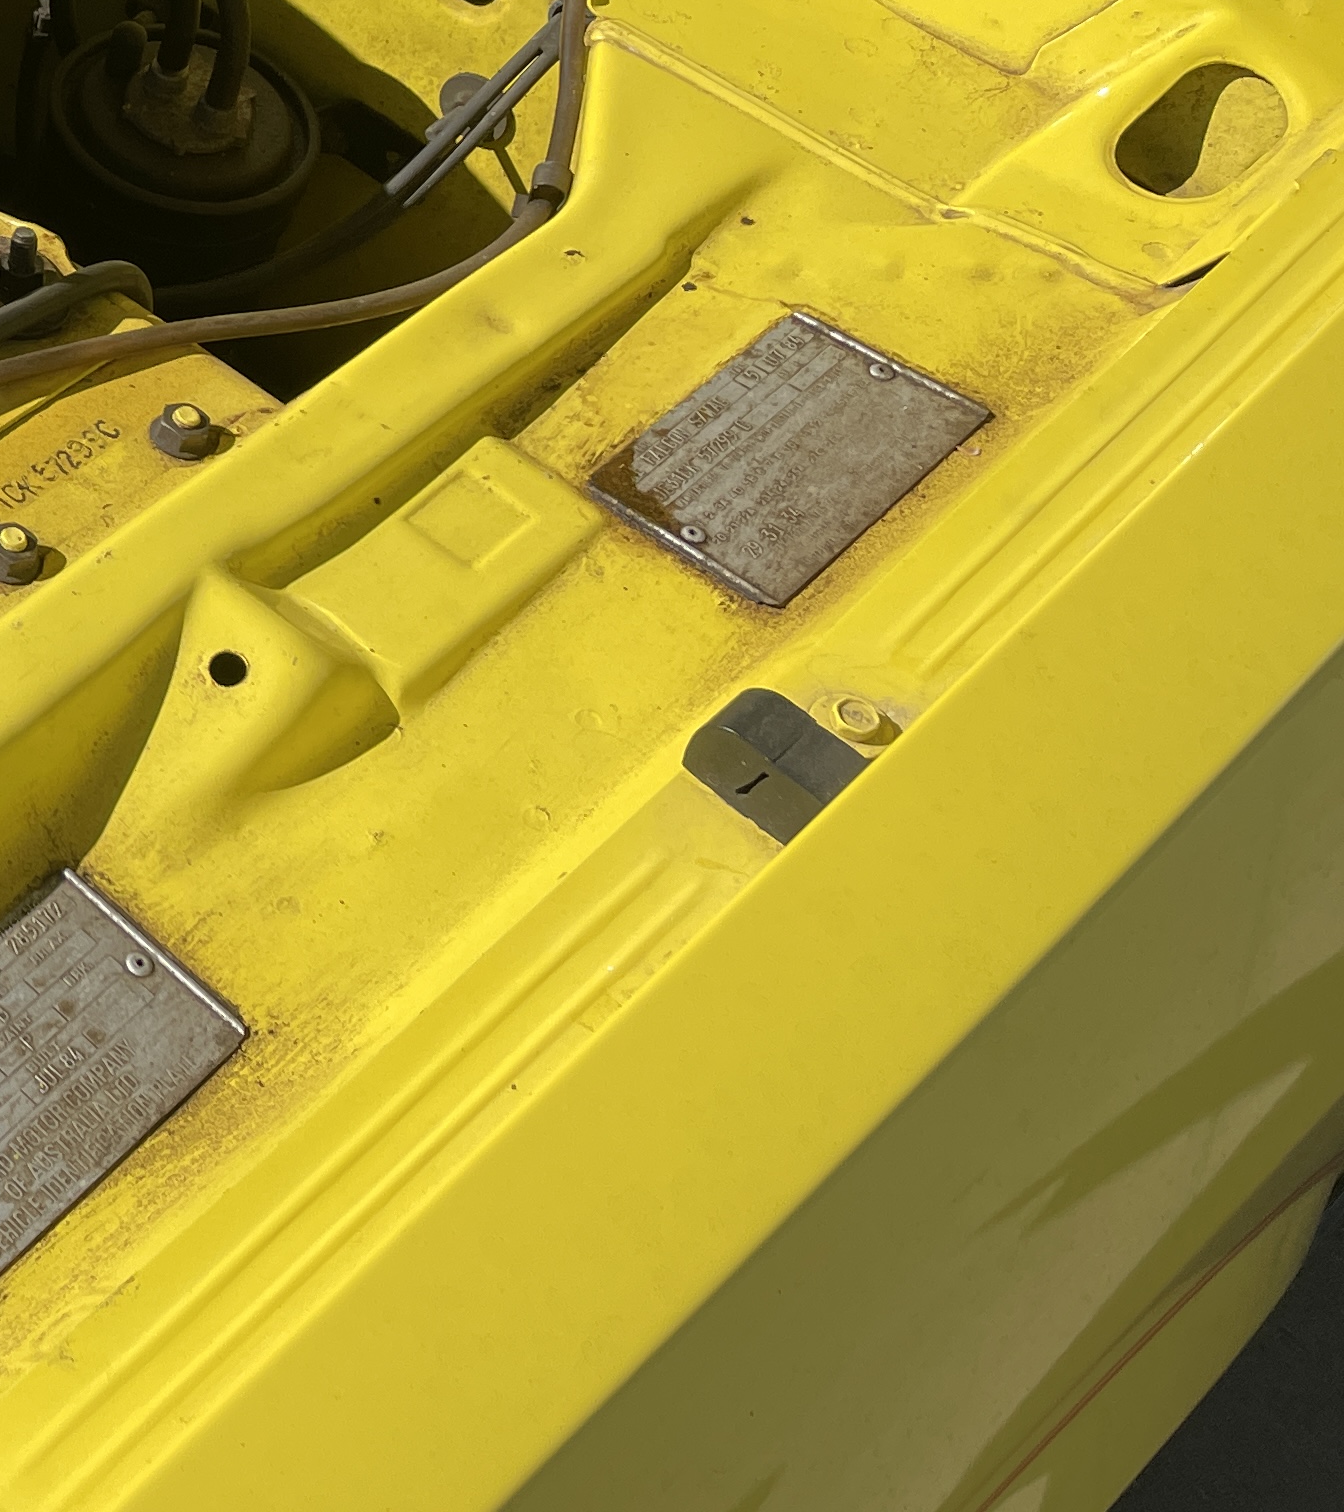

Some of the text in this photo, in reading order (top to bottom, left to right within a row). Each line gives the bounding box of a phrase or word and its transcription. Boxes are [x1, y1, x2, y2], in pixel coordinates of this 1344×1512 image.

[779, 333, 806, 351] 84
[639, 425, 693, 467] FALCON
[685, 394, 732, 429] S/WAG
[694, 427, 742, 464] 57299
[738, 503, 807, 559] 29 31 34
[3, 899, 68, 956] 285172
[20, 1032, 41, 1051] P
[24, 1039, 64, 1075] BUILT
[28, 1042, 86, 1096] JUL 84
[7, 1096, 75, 1160] MOTOR
[66, 1036, 139, 1104] COMPANY
[2, 1070, 143, 1202] OF AUSTRALIA LTD
[38, 1090, 158, 1203] IDENTIFICATION
[146, 1050, 200, 1101] PLATE
